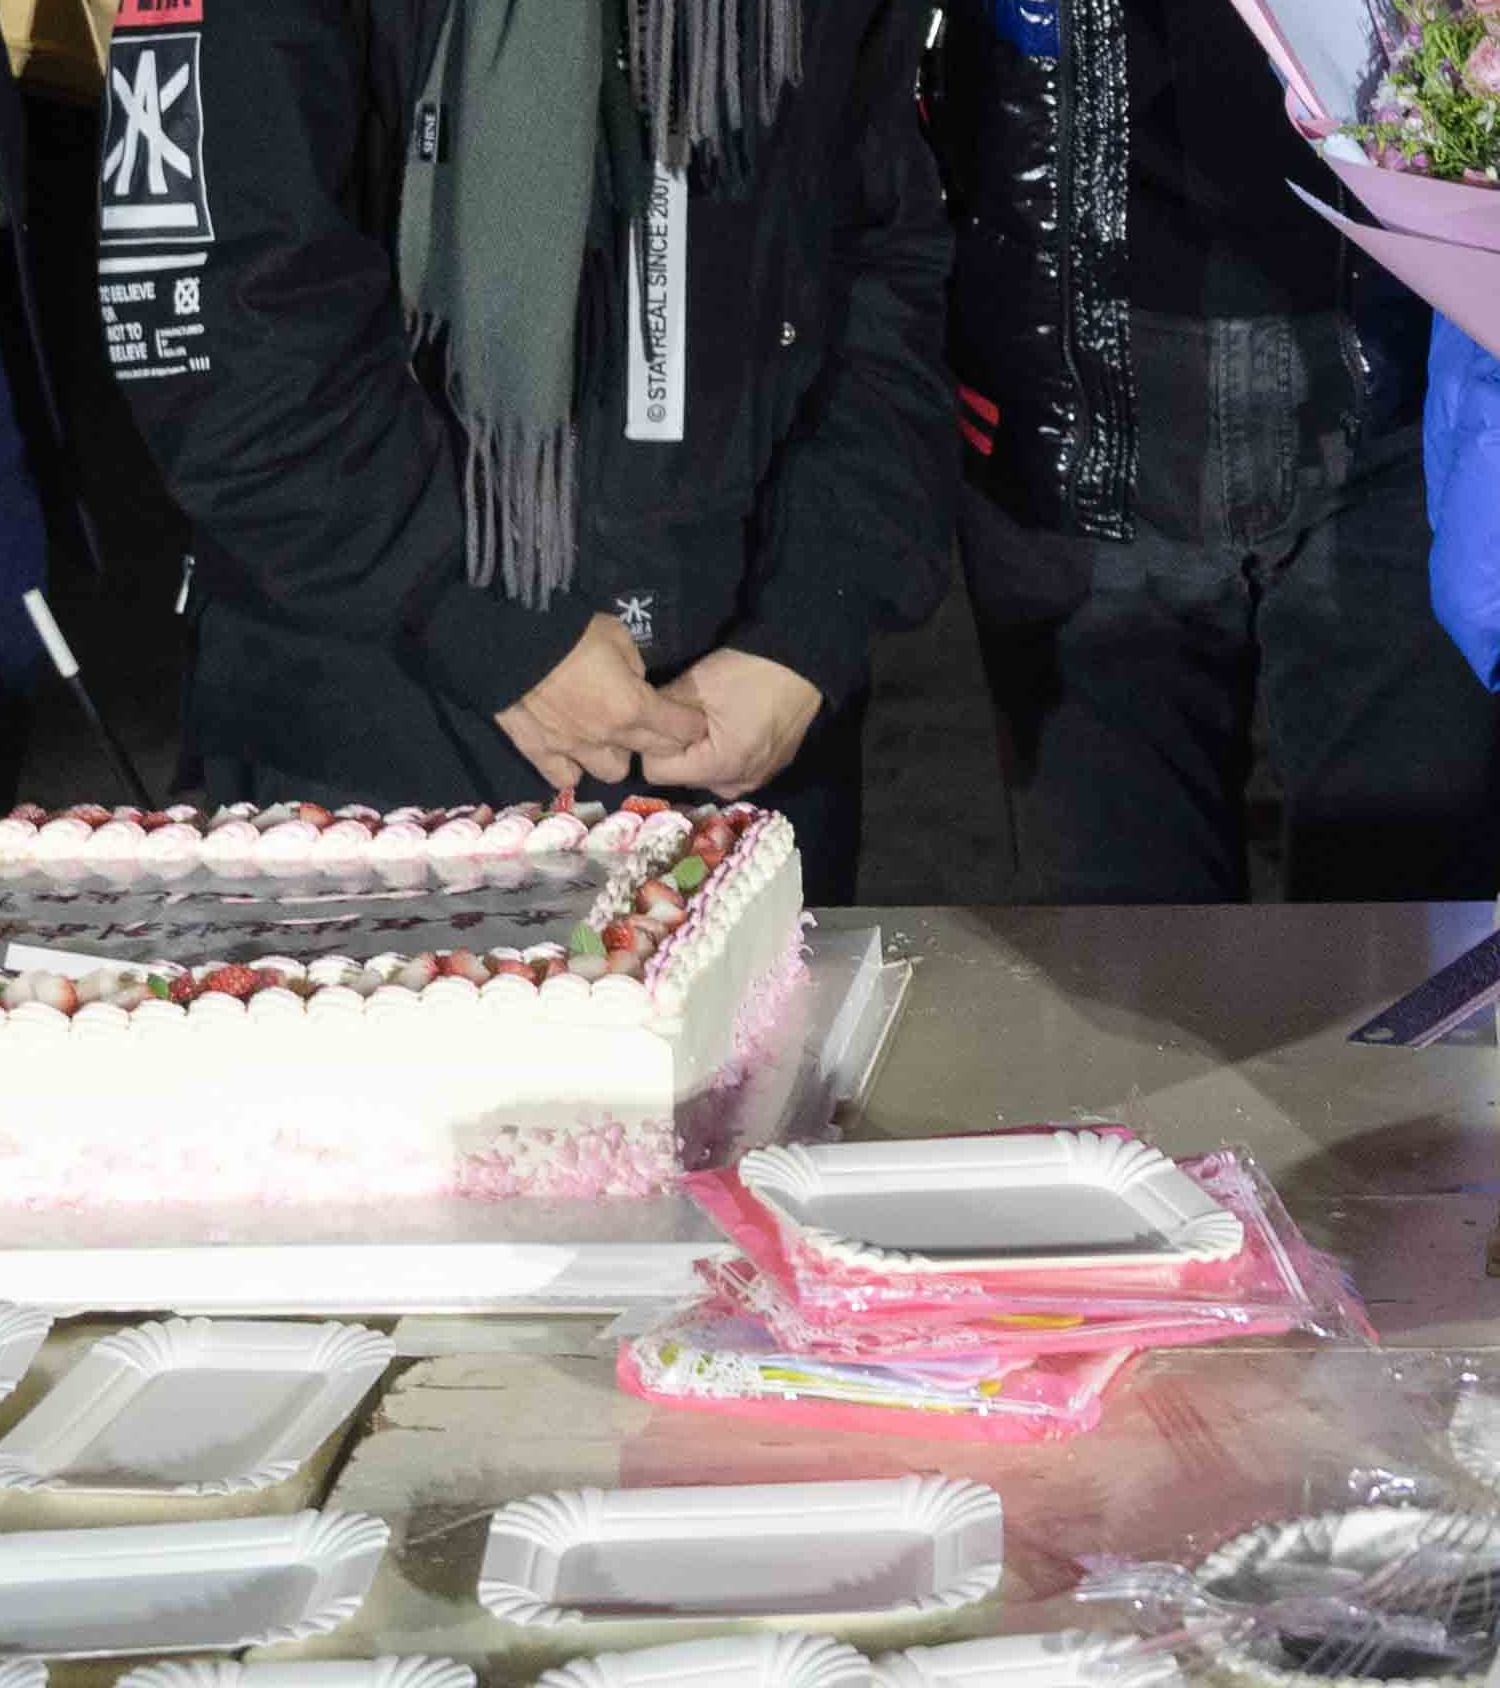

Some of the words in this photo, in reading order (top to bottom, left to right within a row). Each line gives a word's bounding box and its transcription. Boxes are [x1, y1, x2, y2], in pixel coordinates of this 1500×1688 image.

[649, 174, 669, 218] 2007
[648, 224, 669, 287] SINCE
[125, 322, 143, 341] TO
